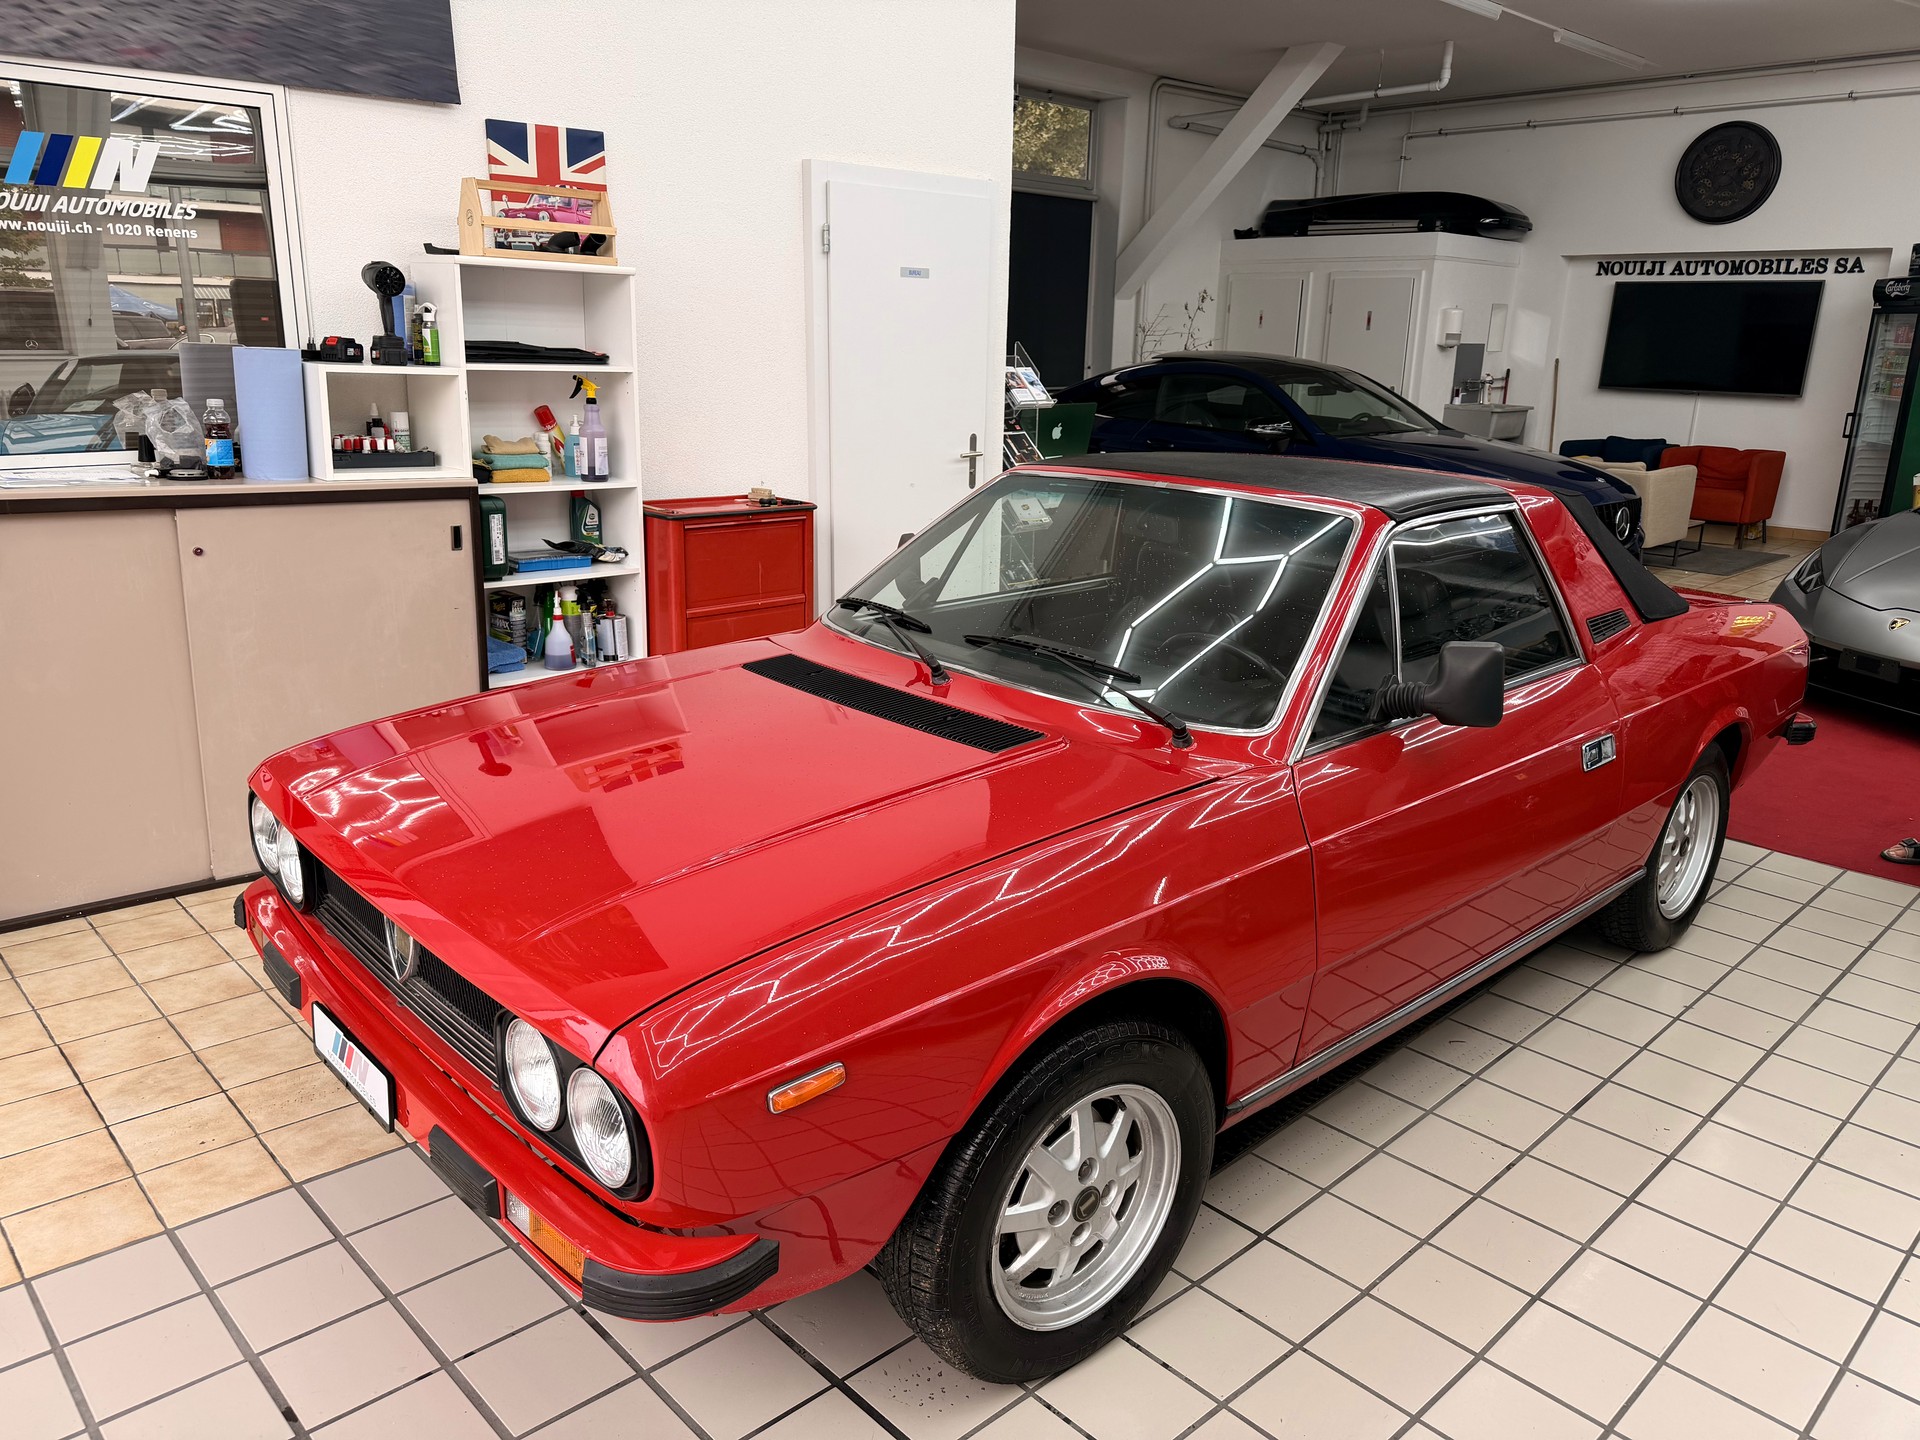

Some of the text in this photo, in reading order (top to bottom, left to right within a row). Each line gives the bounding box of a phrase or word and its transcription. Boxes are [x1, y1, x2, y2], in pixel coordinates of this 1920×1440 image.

[51, 196, 198, 220] AUTOMOBILES
[106, 223, 141, 236] 1020
[145, 225, 198, 238] Renens
[1596, 256, 1865, 276] NOUIJI AUTOMOBILES SA
[1885, 280, 1911, 297] Carlsberg
